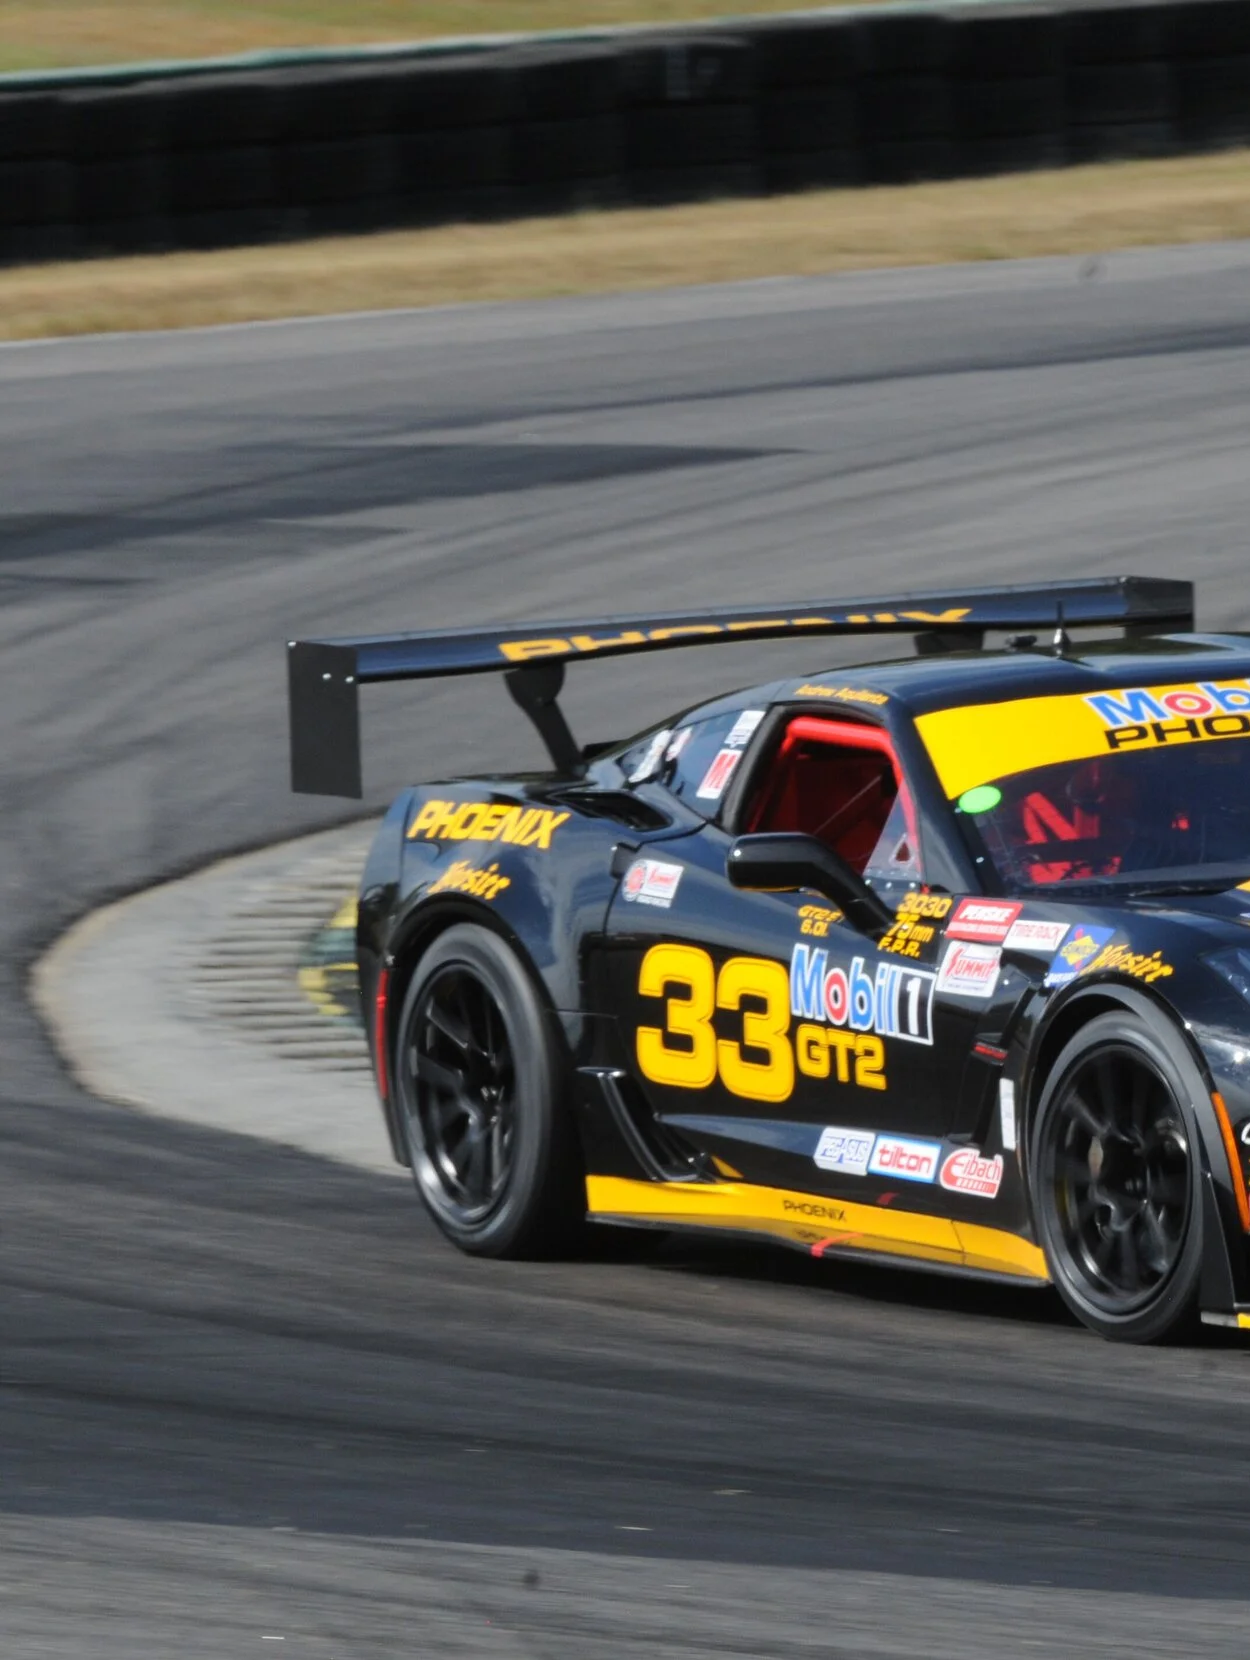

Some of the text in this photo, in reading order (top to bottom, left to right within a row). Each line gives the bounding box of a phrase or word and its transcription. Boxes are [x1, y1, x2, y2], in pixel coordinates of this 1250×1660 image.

[406, 800, 571, 849] PHOENIX
[897, 892, 952, 918] 3030
[789, 943, 900, 1036] Mobil
[636, 943, 795, 1103] 33
[796, 1024, 887, 1090] GT2
[878, 1144, 932, 1174] tilton
[942, 1149, 1002, 1185] Eibach
[784, 1200, 847, 1222] PHOENIX
